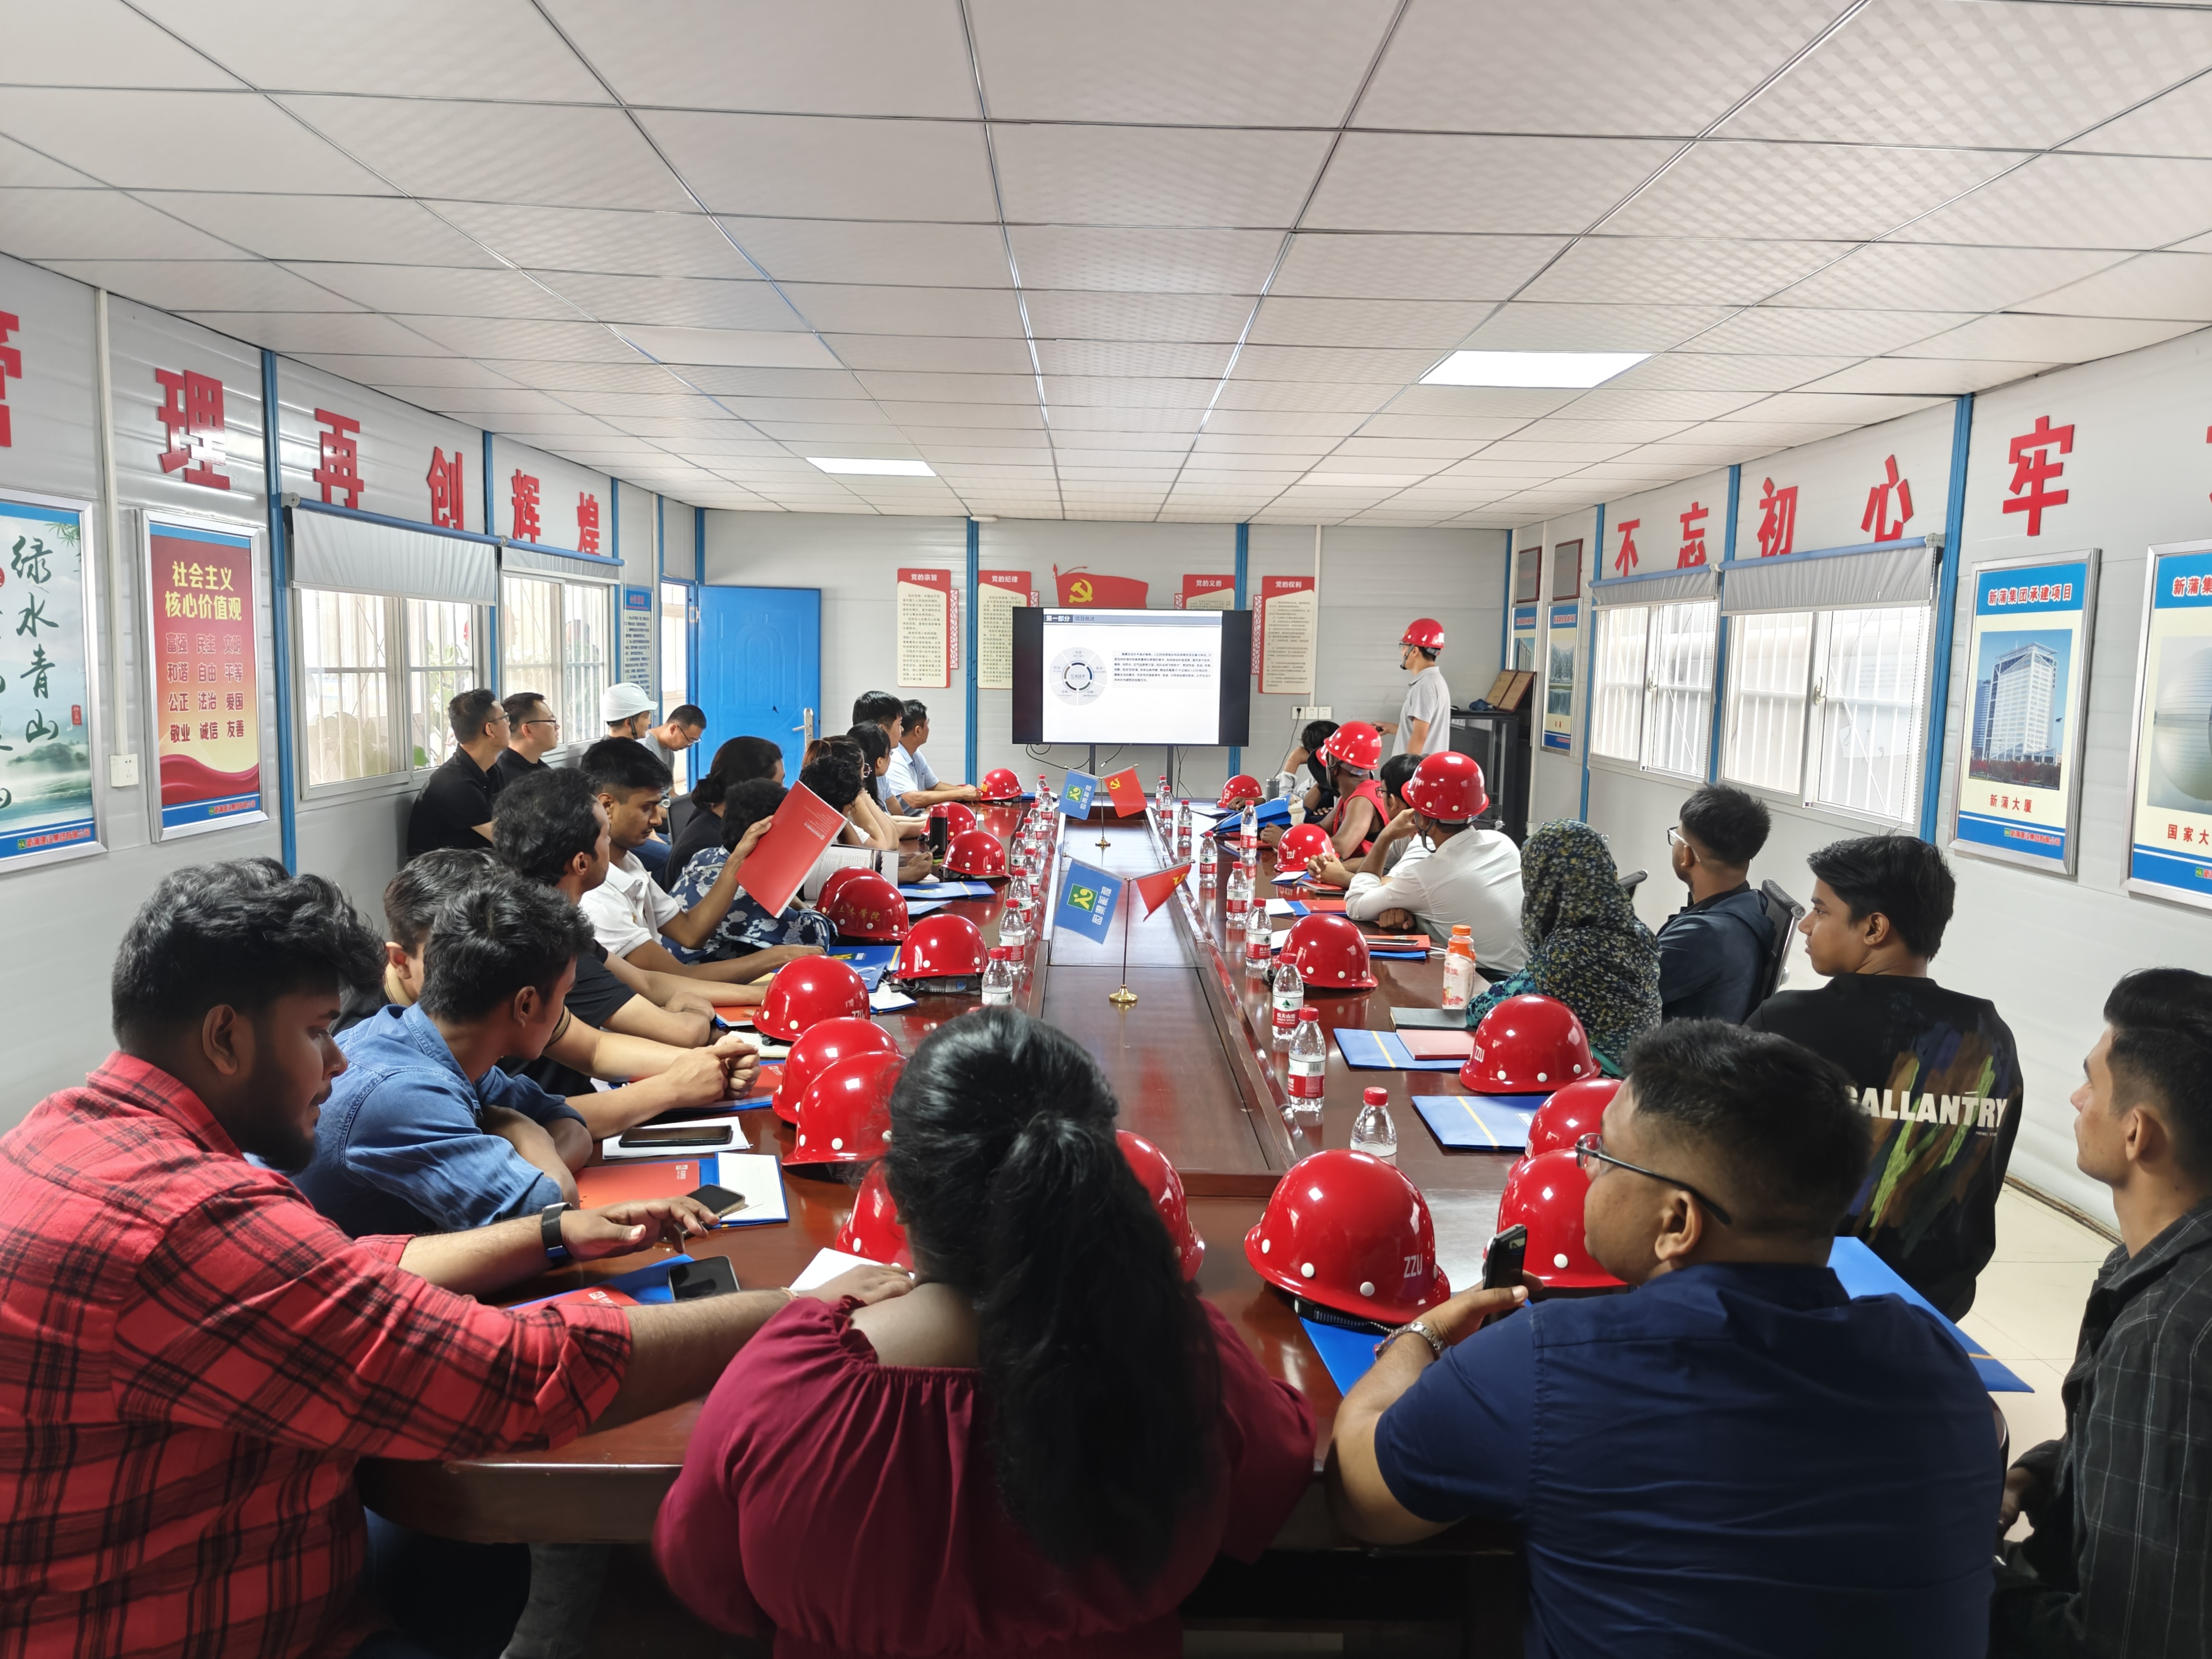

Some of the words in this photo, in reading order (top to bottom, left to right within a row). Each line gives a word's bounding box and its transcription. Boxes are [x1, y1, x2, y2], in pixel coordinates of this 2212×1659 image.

[172, 560, 234, 591] 社会主义
[992, 575, 1019, 583] 党的纪律
[1988, 583, 2073, 606] 新蒲集团承建项目
[165, 591, 242, 621] 核心价值观
[11, 535, 59, 743] 绿水青山
[165, 632, 188, 655] 富强
[196, 634, 216, 655] 民主
[223, 634, 242, 655] 文明
[166, 662, 189, 683] 和谐
[198, 662, 217, 683] 自由
[224, 662, 243, 683] 平等
[168, 691, 190, 712] 公正
[198, 691, 217, 711] 法治
[226, 692, 244, 711] 爱国
[170, 723, 191, 744] 敬业
[199, 720, 219, 740] 诚信
[226, 719, 245, 739] 友善
[1990, 793, 2032, 813] 新蒲大厦
[2167, 824, 2210, 846] 国家大
[838, 904, 881, 921] 土木学院
[1474, 1045, 1485, 1063] ZZU
[1403, 1253, 1423, 1279] ZZU
